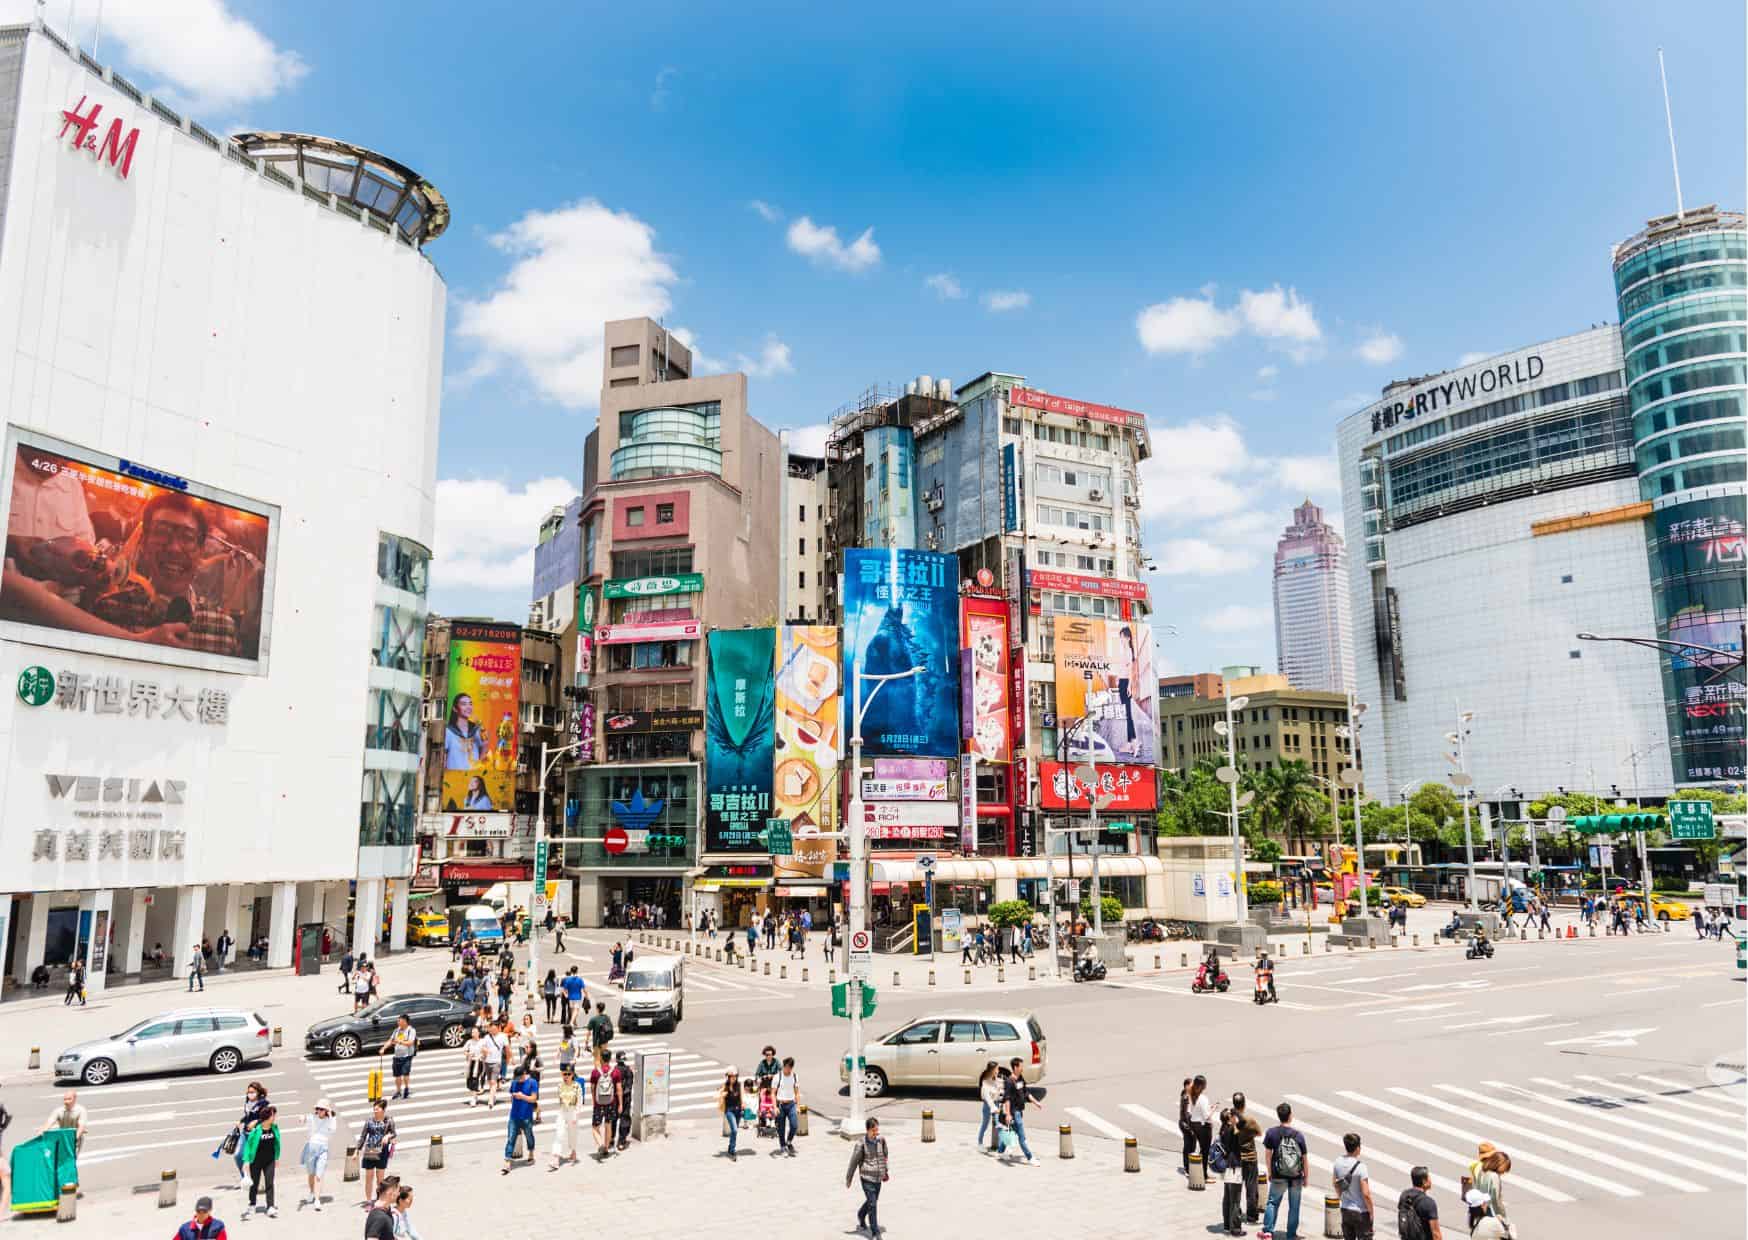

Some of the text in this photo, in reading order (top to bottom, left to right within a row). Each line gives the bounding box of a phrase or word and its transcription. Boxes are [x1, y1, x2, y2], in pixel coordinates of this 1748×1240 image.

[60, 95, 140, 179] H&M
[31, 458, 58, 474] 4/26
[55, 669, 231, 724] 新世界大樓
[32, 828, 187, 863] 真善美劇院
